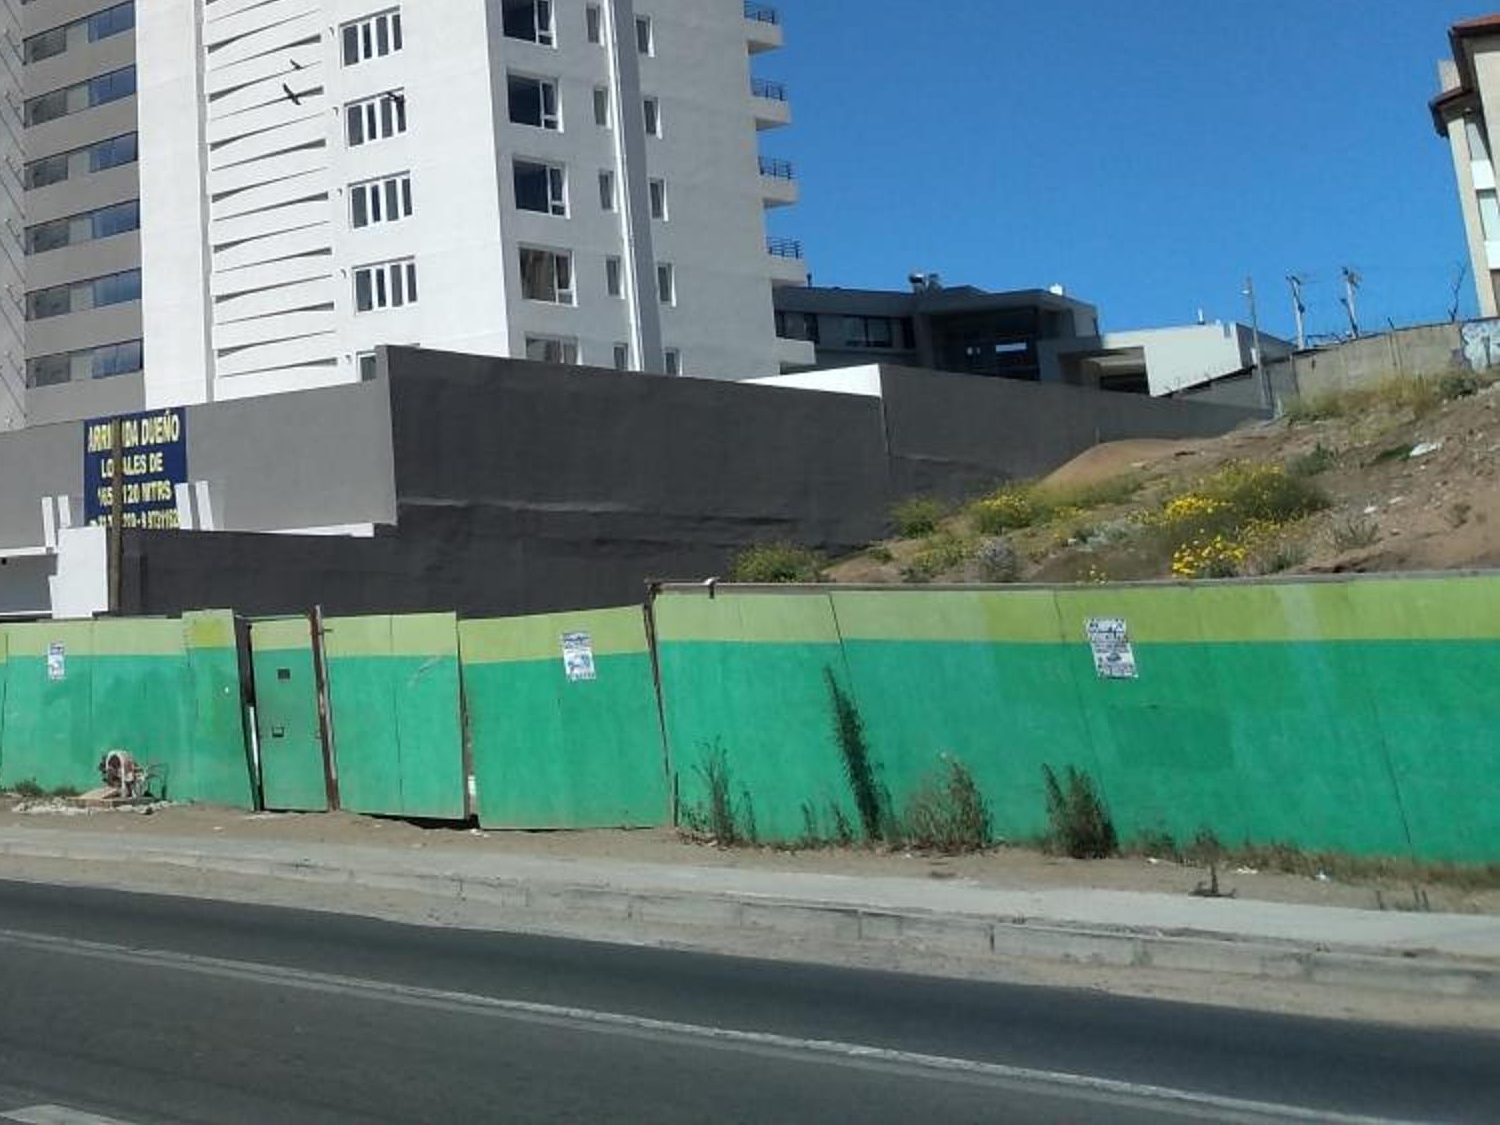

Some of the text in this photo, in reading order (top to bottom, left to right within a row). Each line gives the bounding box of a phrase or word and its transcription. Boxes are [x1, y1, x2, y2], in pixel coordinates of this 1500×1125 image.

[88, 409, 179, 452] ARRIDA DUEÑO
[101, 452, 164, 479] LOALES DE
[123, 482, 140, 504] 120
[141, 479, 172, 502] MTRS
